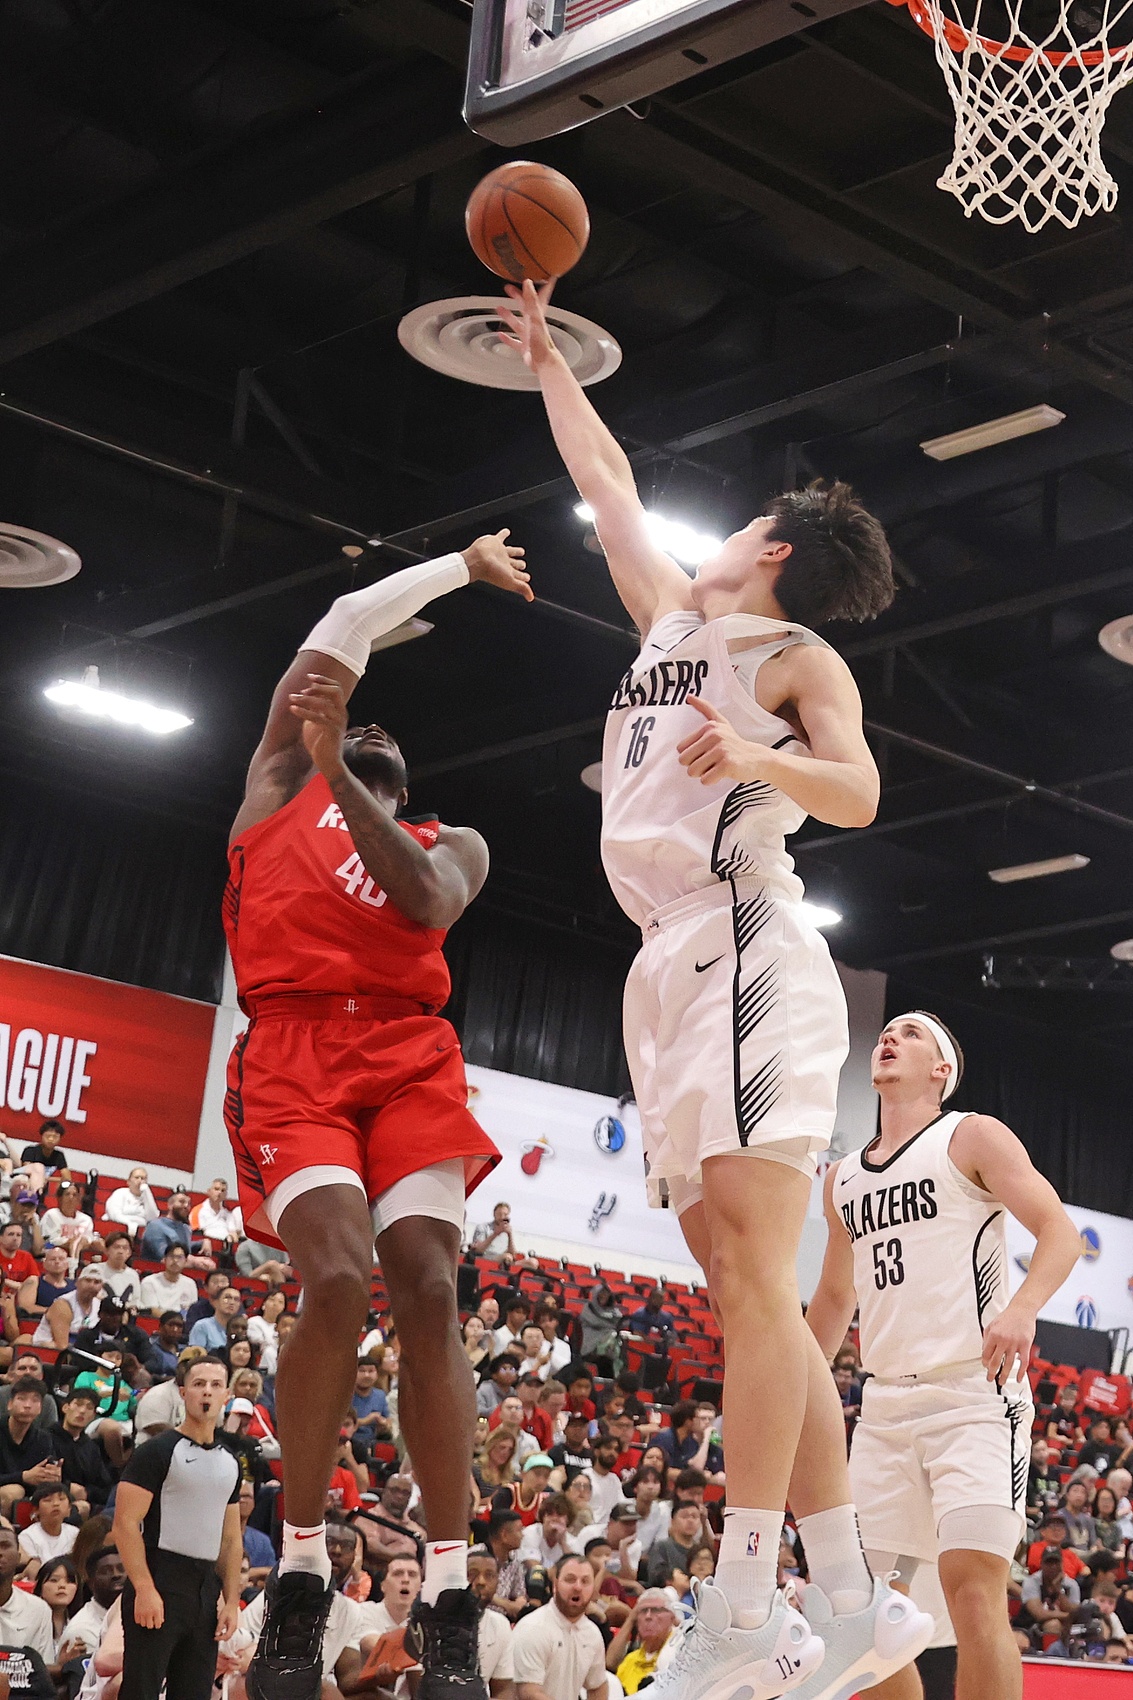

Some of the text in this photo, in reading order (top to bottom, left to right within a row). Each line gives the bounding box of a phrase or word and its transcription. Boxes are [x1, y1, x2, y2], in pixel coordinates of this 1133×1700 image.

[624, 716, 656, 769] 16
[841, 1178, 938, 1244] BLAZERS
[872, 1237, 905, 1291] 53
[775, 1654, 794, 1680] 11
